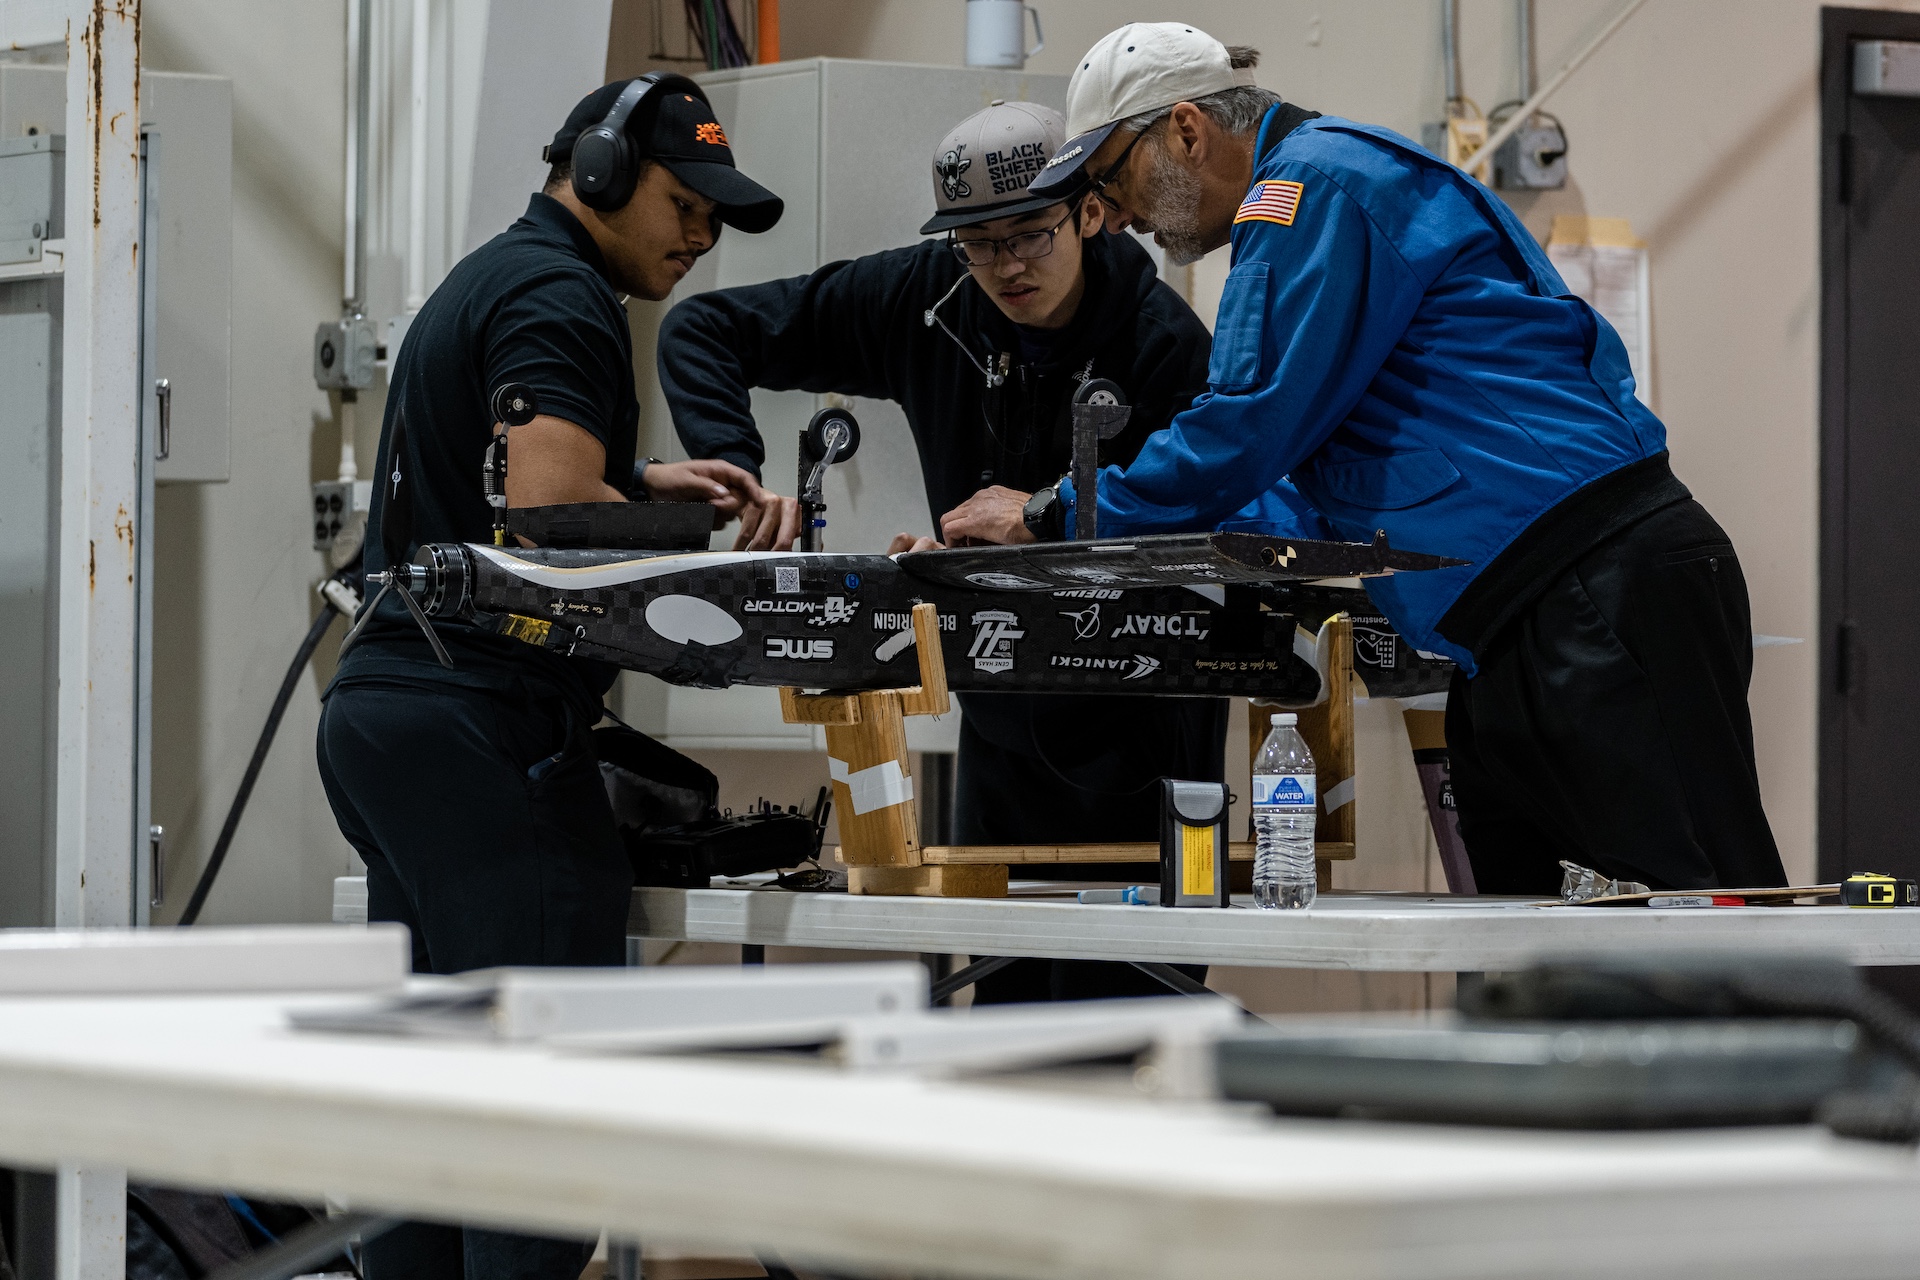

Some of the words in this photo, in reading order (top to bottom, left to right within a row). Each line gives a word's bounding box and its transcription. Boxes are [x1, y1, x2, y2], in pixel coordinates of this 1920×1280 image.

[985, 142, 1045, 167] BLACK
[1045, 145, 1083, 169] Cessna
[988, 157, 1047, 181] SHEEP
[1050, 655, 1130, 671] JANICKI
[1195, 659, 1219, 671] Family
[1274, 792, 1304, 800] WATER
